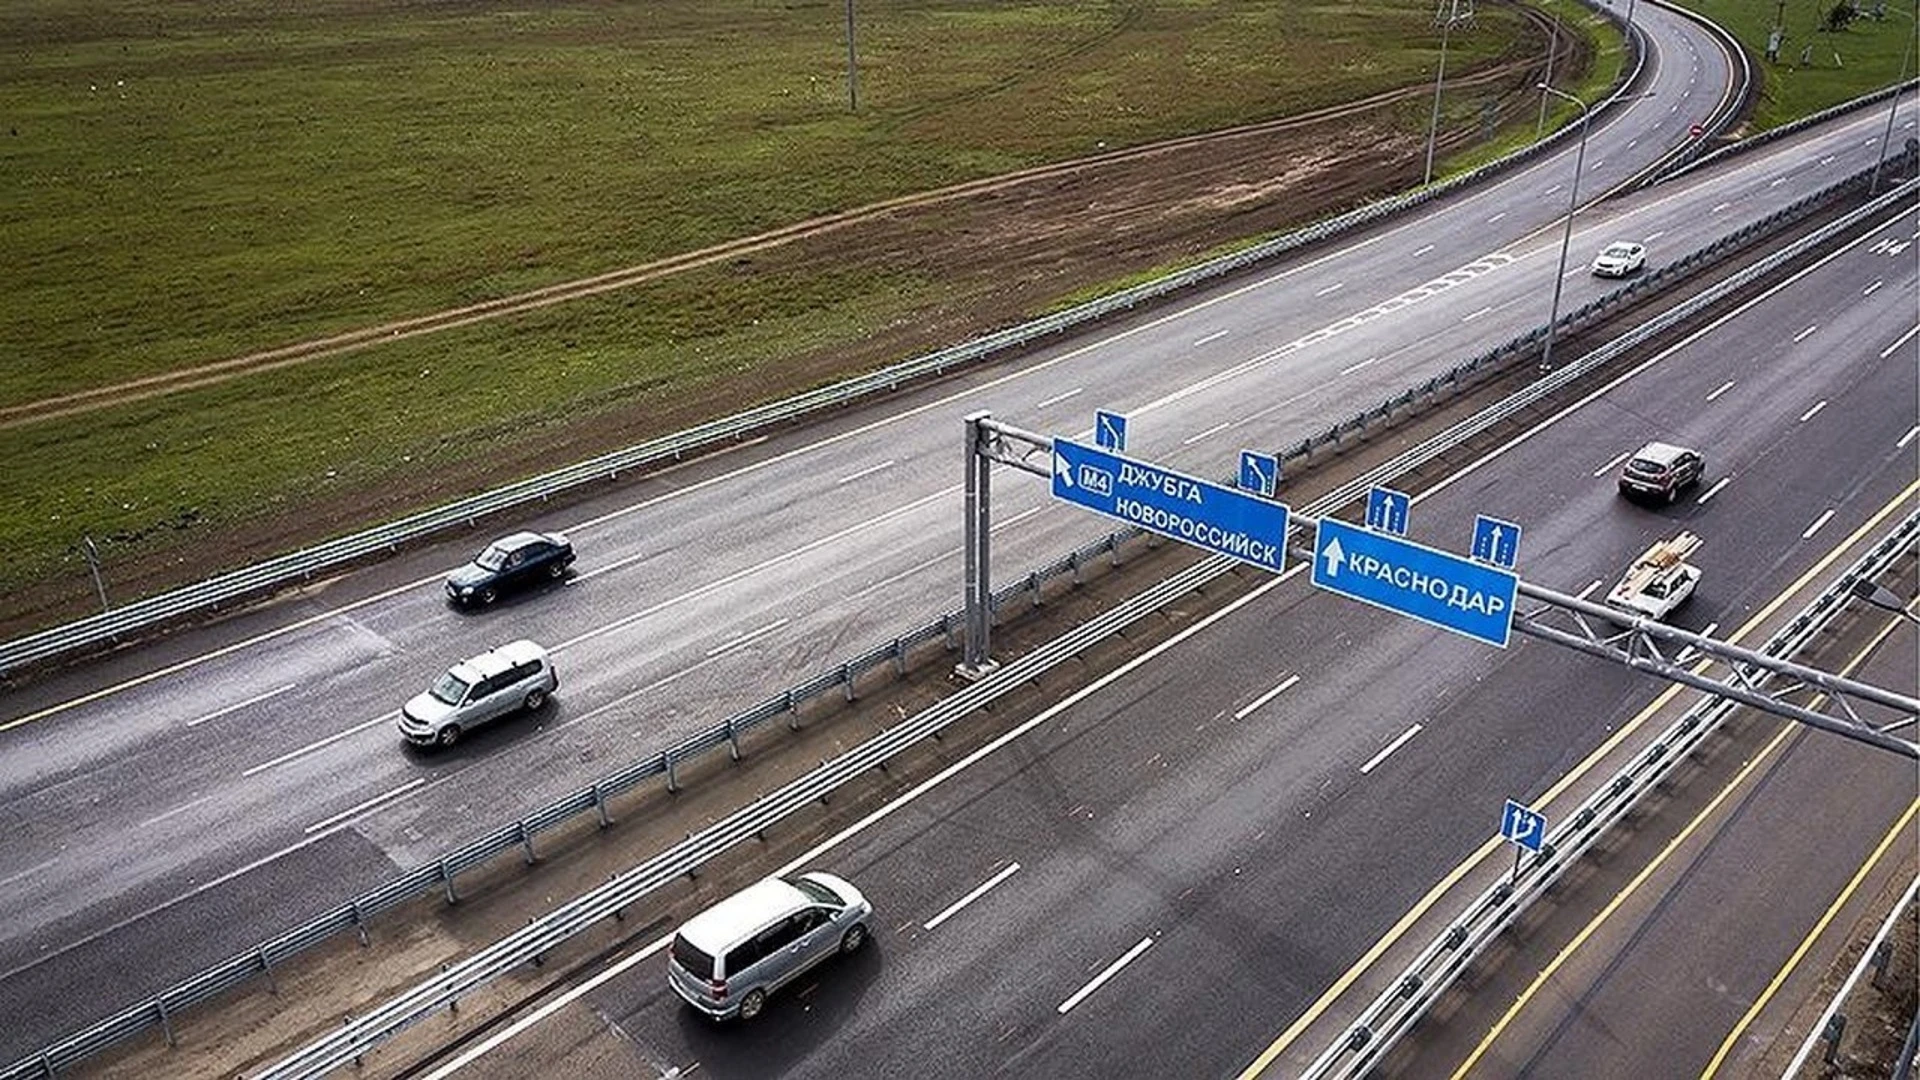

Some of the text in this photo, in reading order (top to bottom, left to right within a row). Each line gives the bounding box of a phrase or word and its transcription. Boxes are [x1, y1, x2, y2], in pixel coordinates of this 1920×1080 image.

[1118, 463, 1203, 504] ДЖУБГА
[1116, 498, 1277, 565] НОВОРОССИЙСК
[1349, 551, 1505, 617] КРАСНОДАР
